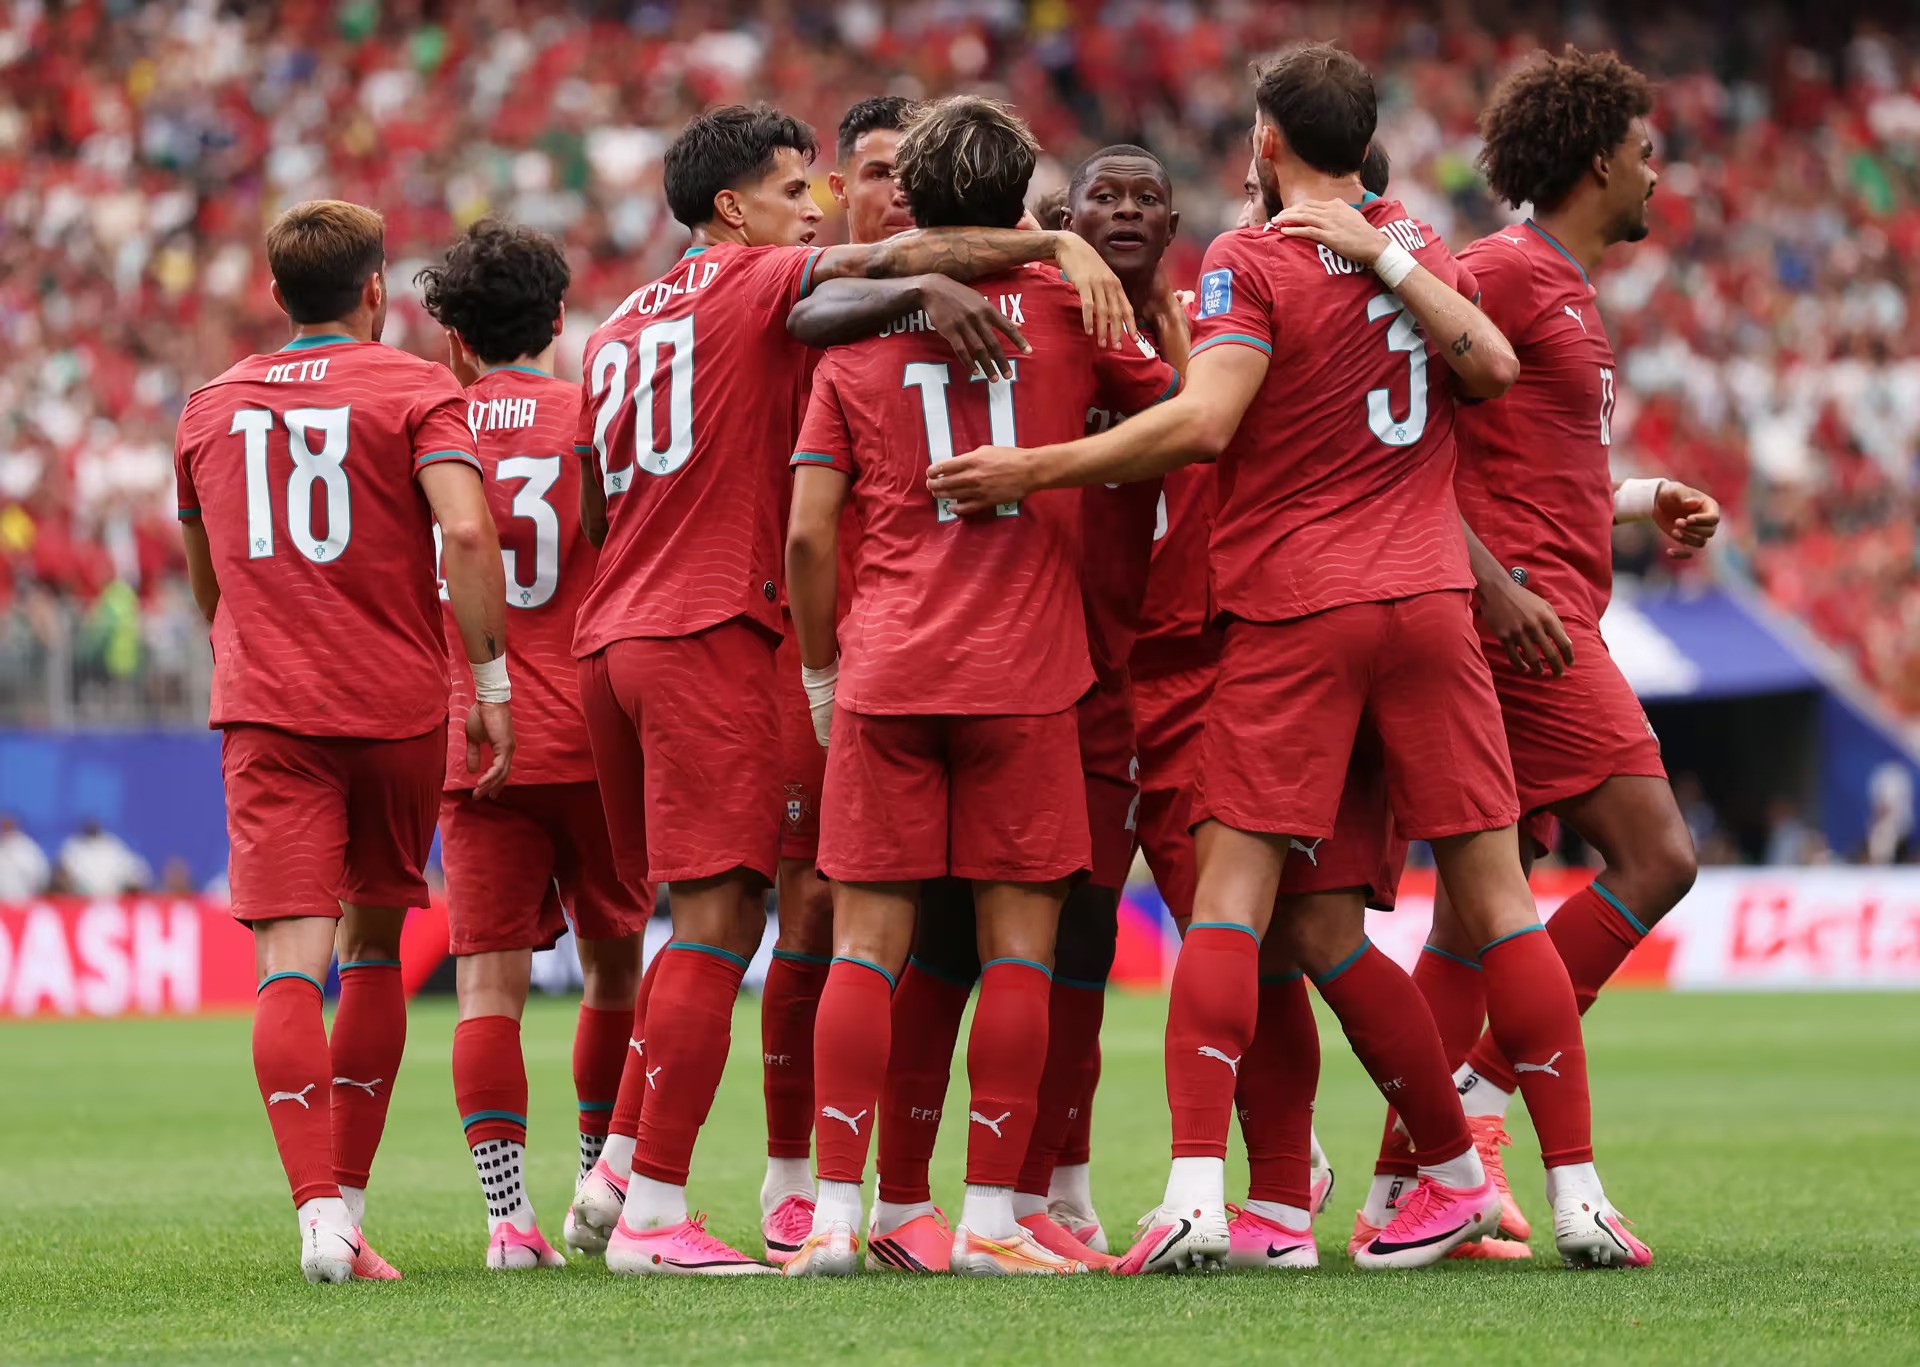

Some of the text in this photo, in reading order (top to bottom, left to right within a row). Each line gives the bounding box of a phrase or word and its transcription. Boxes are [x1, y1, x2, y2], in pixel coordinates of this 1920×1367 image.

[264, 358, 331, 383] NETO
[591, 312, 695, 497] 20
[902, 359, 1021, 523] 11
[1366, 292, 1428, 446] 3
[228, 404, 353, 563] 18
[0, 900, 202, 1018] ASH
